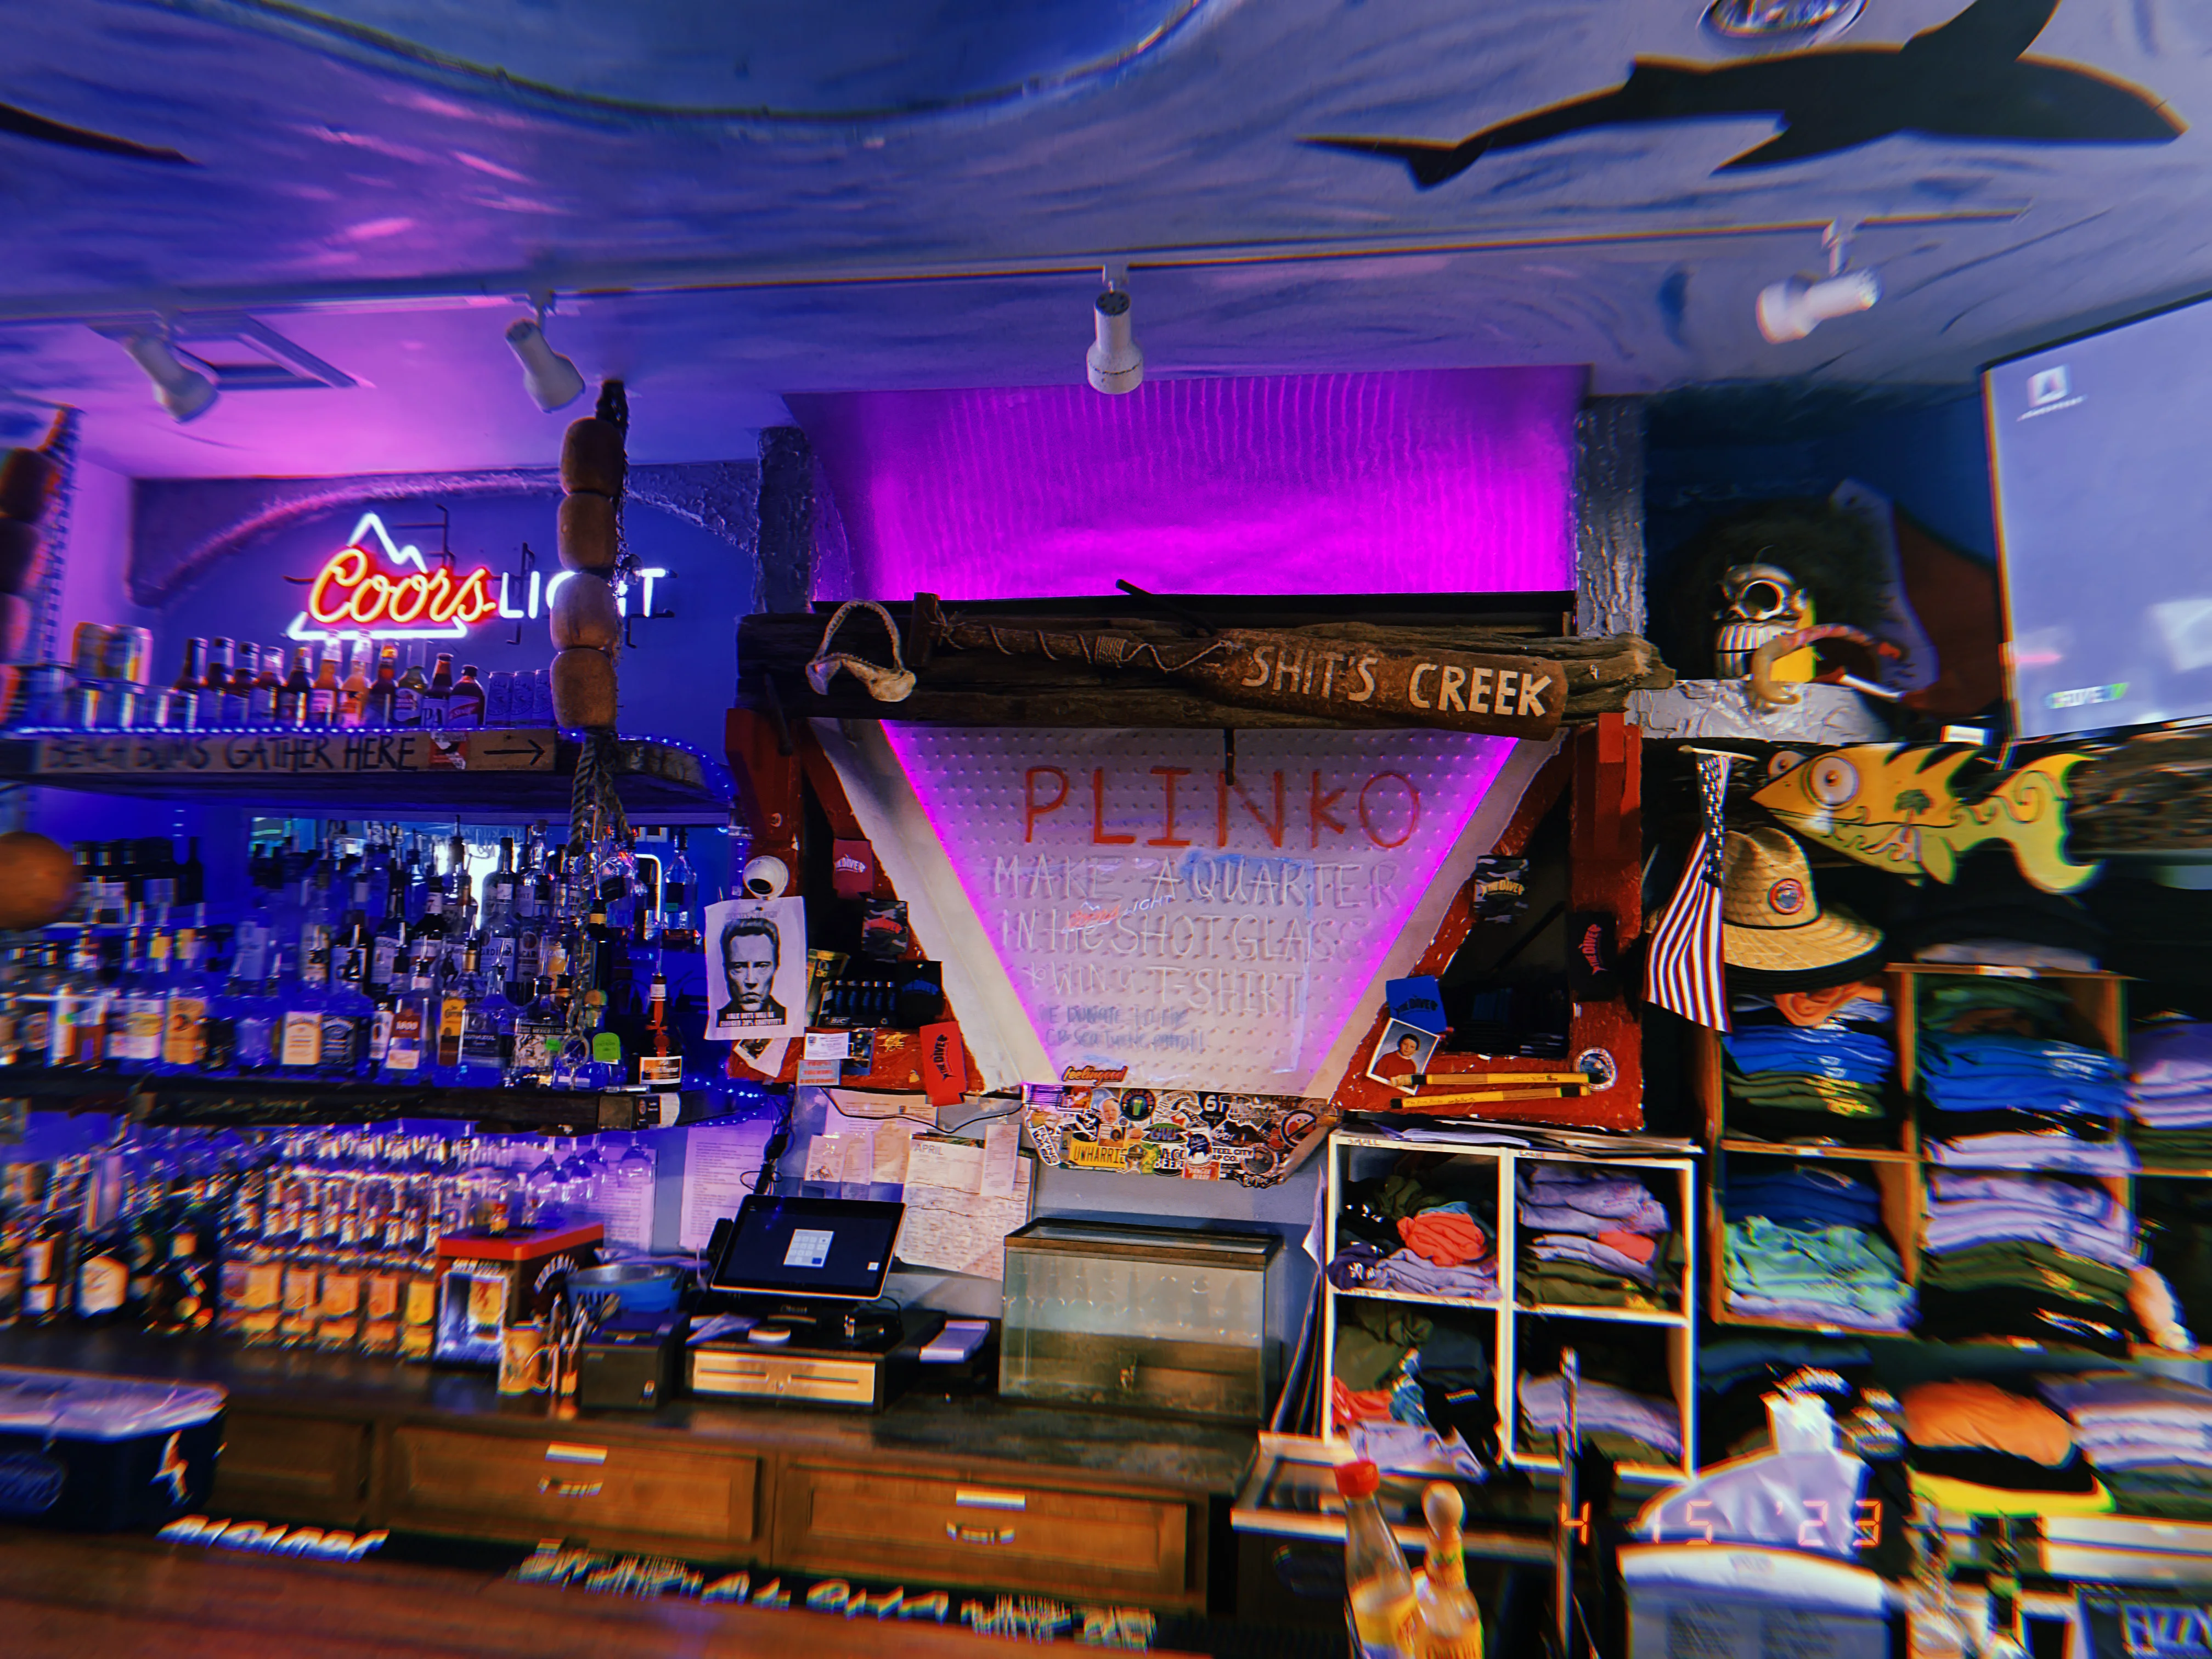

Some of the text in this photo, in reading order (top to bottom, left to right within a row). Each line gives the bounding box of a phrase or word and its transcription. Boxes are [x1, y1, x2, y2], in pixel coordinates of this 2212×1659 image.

[310, 548, 666, 623] Coors LIT
[1241, 646, 1553, 716] SHIT'S CREEK
[224, 735, 335, 770] GATHER
[344, 735, 418, 771] HERE
[1025, 766, 1420, 848] PLINKO
[994, 854, 1401, 909] MAKE A QUARTER
[1111, 911, 1227, 958] SHOT
[1233, 912, 1372, 962] GLASS
[1051, 962, 1107, 996] WIN
[1147, 966, 1304, 1018] T-SHIRT
[396, 1020, 419, 1030] 1800
[914, 1143, 943, 1155] APRIL
[1347, 1138, 1381, 1147] SMALL
